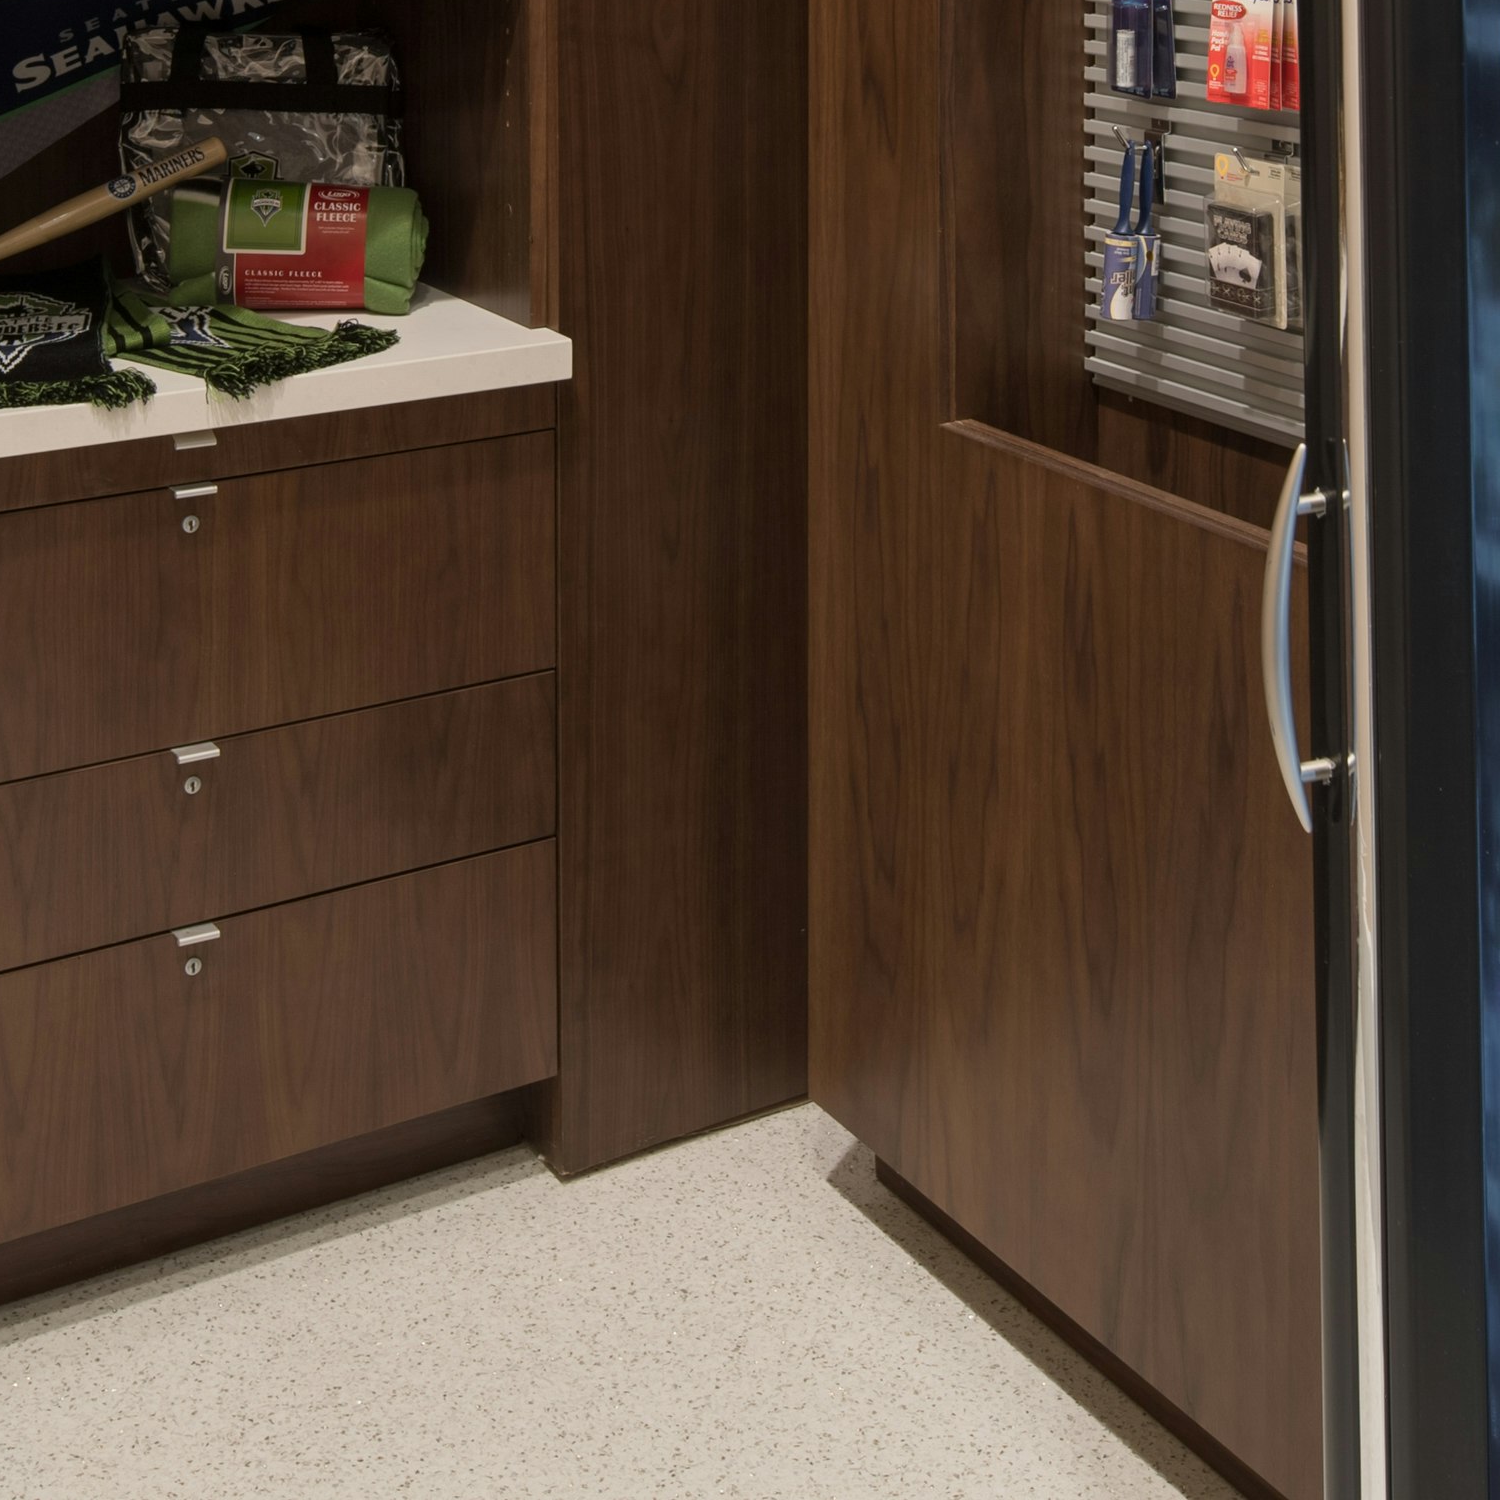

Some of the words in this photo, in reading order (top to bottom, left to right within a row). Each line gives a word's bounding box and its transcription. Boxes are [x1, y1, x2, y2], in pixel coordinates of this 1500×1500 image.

[1214, 3, 1242, 12] REDNESS
[1217, 9, 1238, 18] RELIEF
[138, 146, 205, 187] MARINERS
[314, 202, 361, 211] CLASSIC
[316, 212, 357, 222] FLEECE
[244, 269, 285, 277] CLASSIC
[55, 321, 80, 332] FC
